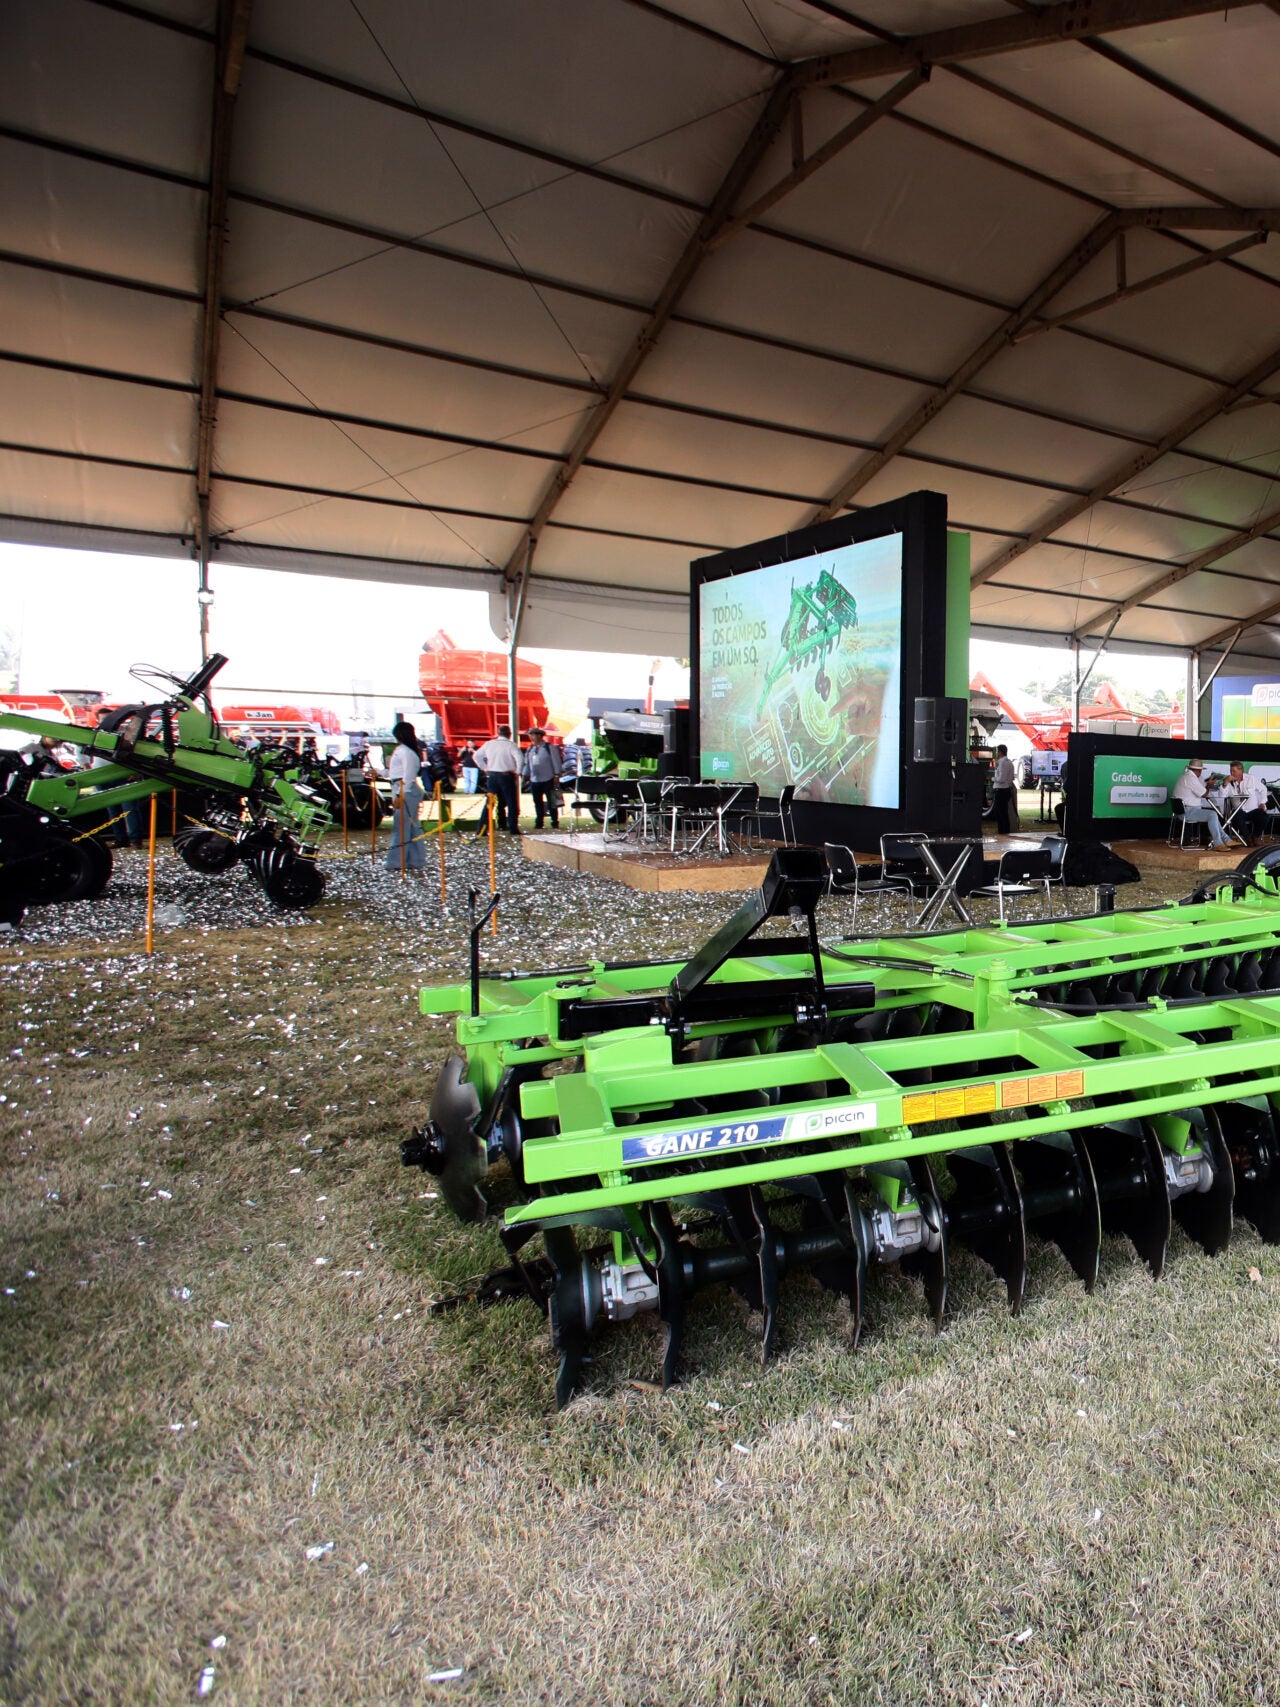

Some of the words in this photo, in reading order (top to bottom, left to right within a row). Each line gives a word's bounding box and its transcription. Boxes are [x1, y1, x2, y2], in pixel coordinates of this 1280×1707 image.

[712, 603, 743, 624] TODOS
[712, 629, 725, 646] OS
[726, 620, 767, 644] CAMPOS
[712, 650, 725, 668] EM
[727, 647, 742, 666] UM
[1111, 772, 1142, 782] Grades
[825, 1110, 865, 1127] piccin
[645, 1131, 713, 1156] GANF
[718, 1124, 759, 1146] 210
